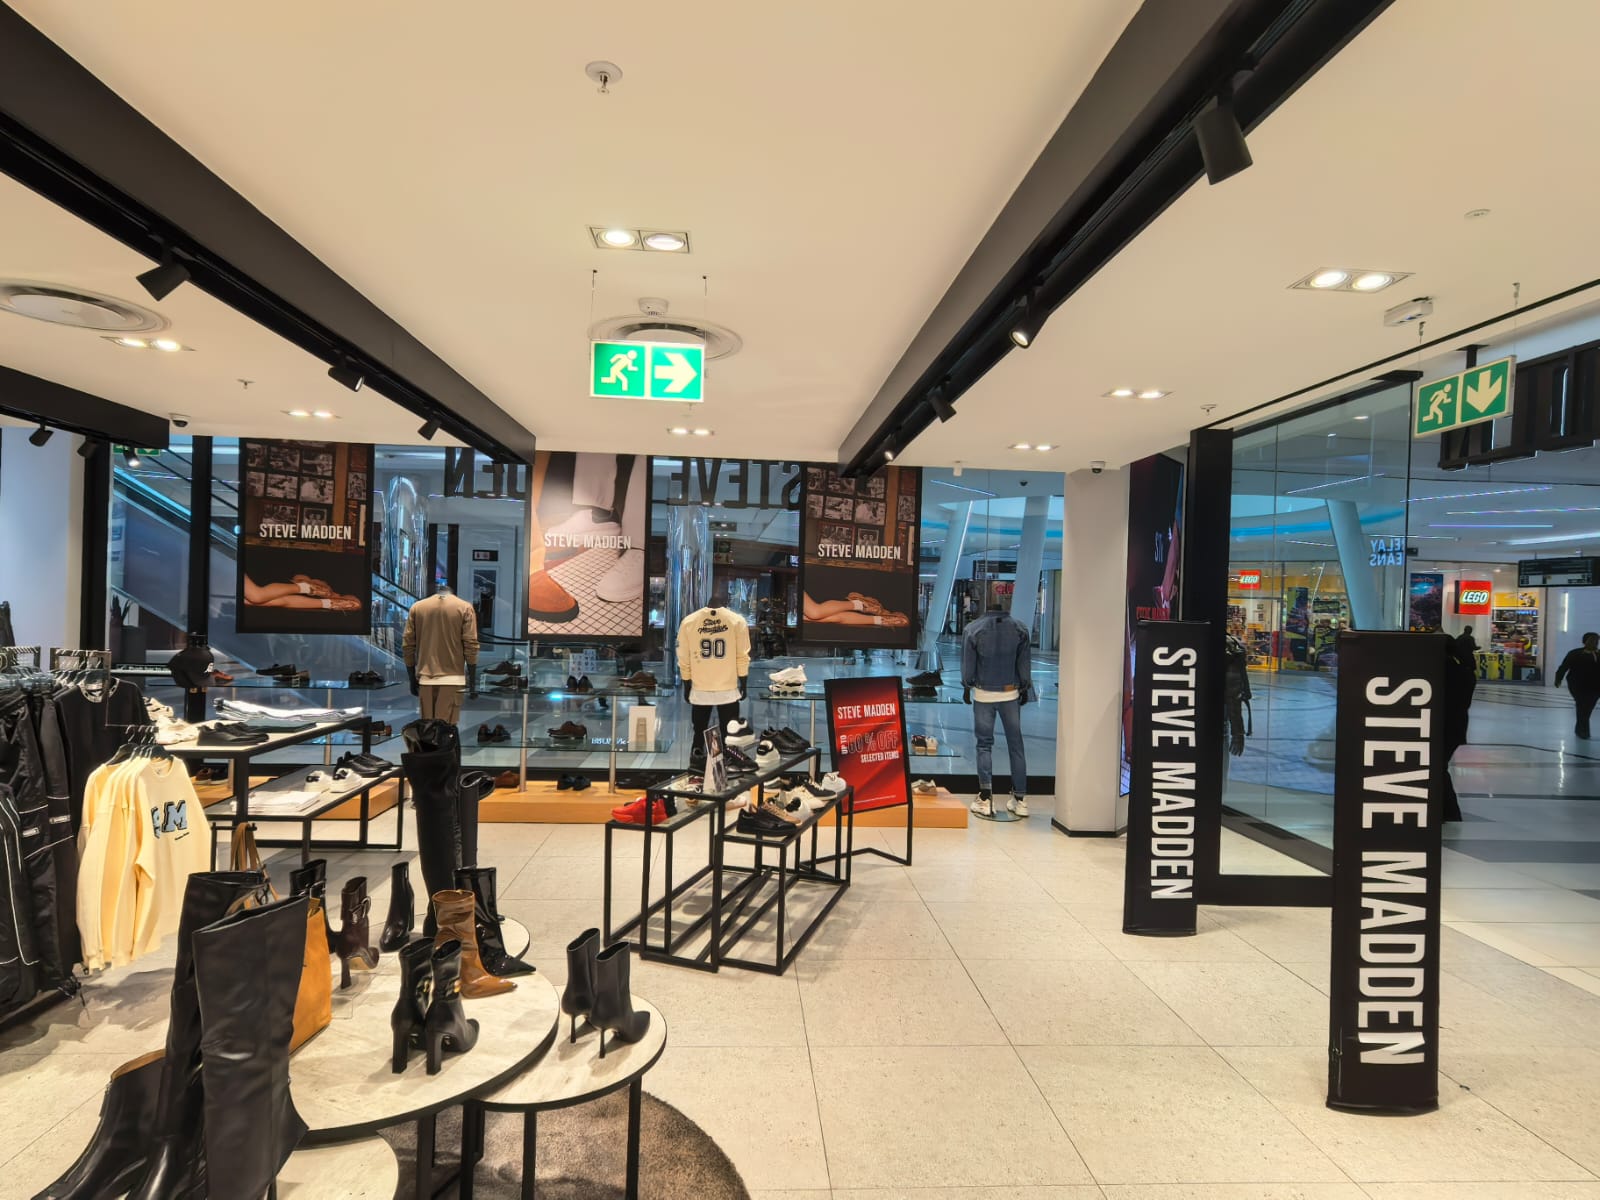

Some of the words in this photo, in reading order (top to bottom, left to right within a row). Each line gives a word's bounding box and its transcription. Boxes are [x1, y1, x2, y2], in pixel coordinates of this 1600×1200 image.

[260, 523, 297, 539] STEVE
[301, 524, 352, 541] MADDEN
[544, 532, 580, 549] STEVE
[583, 534, 633, 550] MADDEN
[818, 543, 853, 559] STEVE
[855, 544, 901, 560] MADDEN
[1241, 576, 1259, 584] LEGO
[1461, 590, 1489, 605] LEGO
[701, 639, 726, 659] 90
[1151, 646, 1198, 748] STEVE
[837, 706, 862, 719] STEVE
[864, 704, 896, 717] MADDEN
[840, 734, 847, 744] TO
[877, 730, 897, 750] OFF
[841, 744, 848, 755] UP
[861, 753, 884, 763] SELECTED
[885, 751, 899, 760] ITEMS
[1362, 677, 1433, 829] STEVE
[1150, 761, 1197, 900] MADDEN
[1358, 852, 1427, 1064] MADDEN
